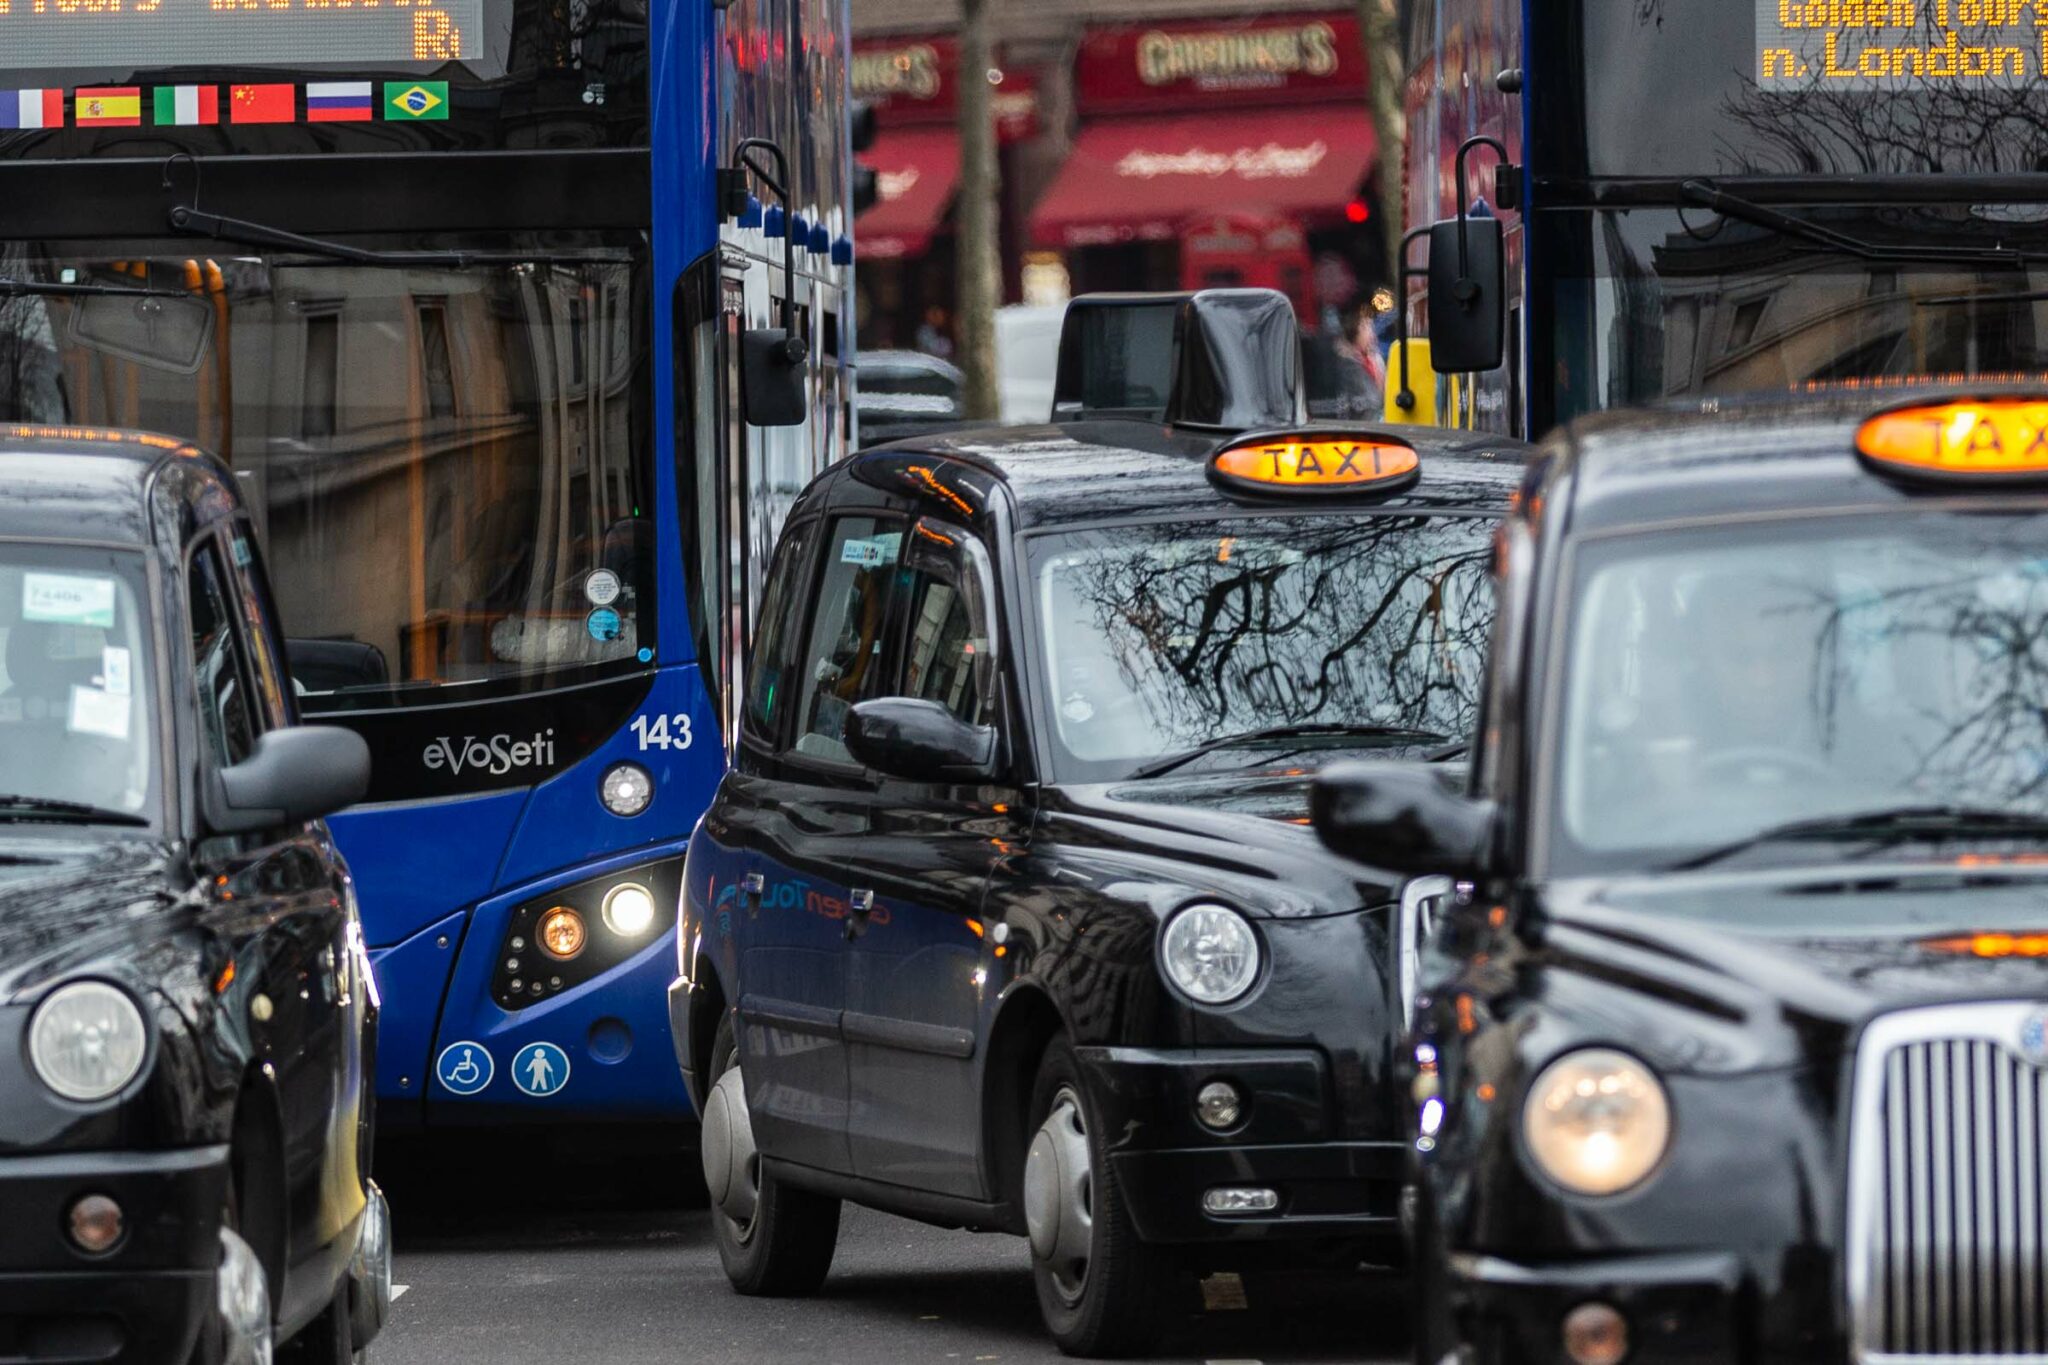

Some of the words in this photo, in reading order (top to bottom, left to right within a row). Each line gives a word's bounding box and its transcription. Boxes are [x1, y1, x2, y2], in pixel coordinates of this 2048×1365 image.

[1825, 31, 2024, 76] London
[1263, 447, 1381, 476] TAXI
[630, 714, 692, 750] 143
